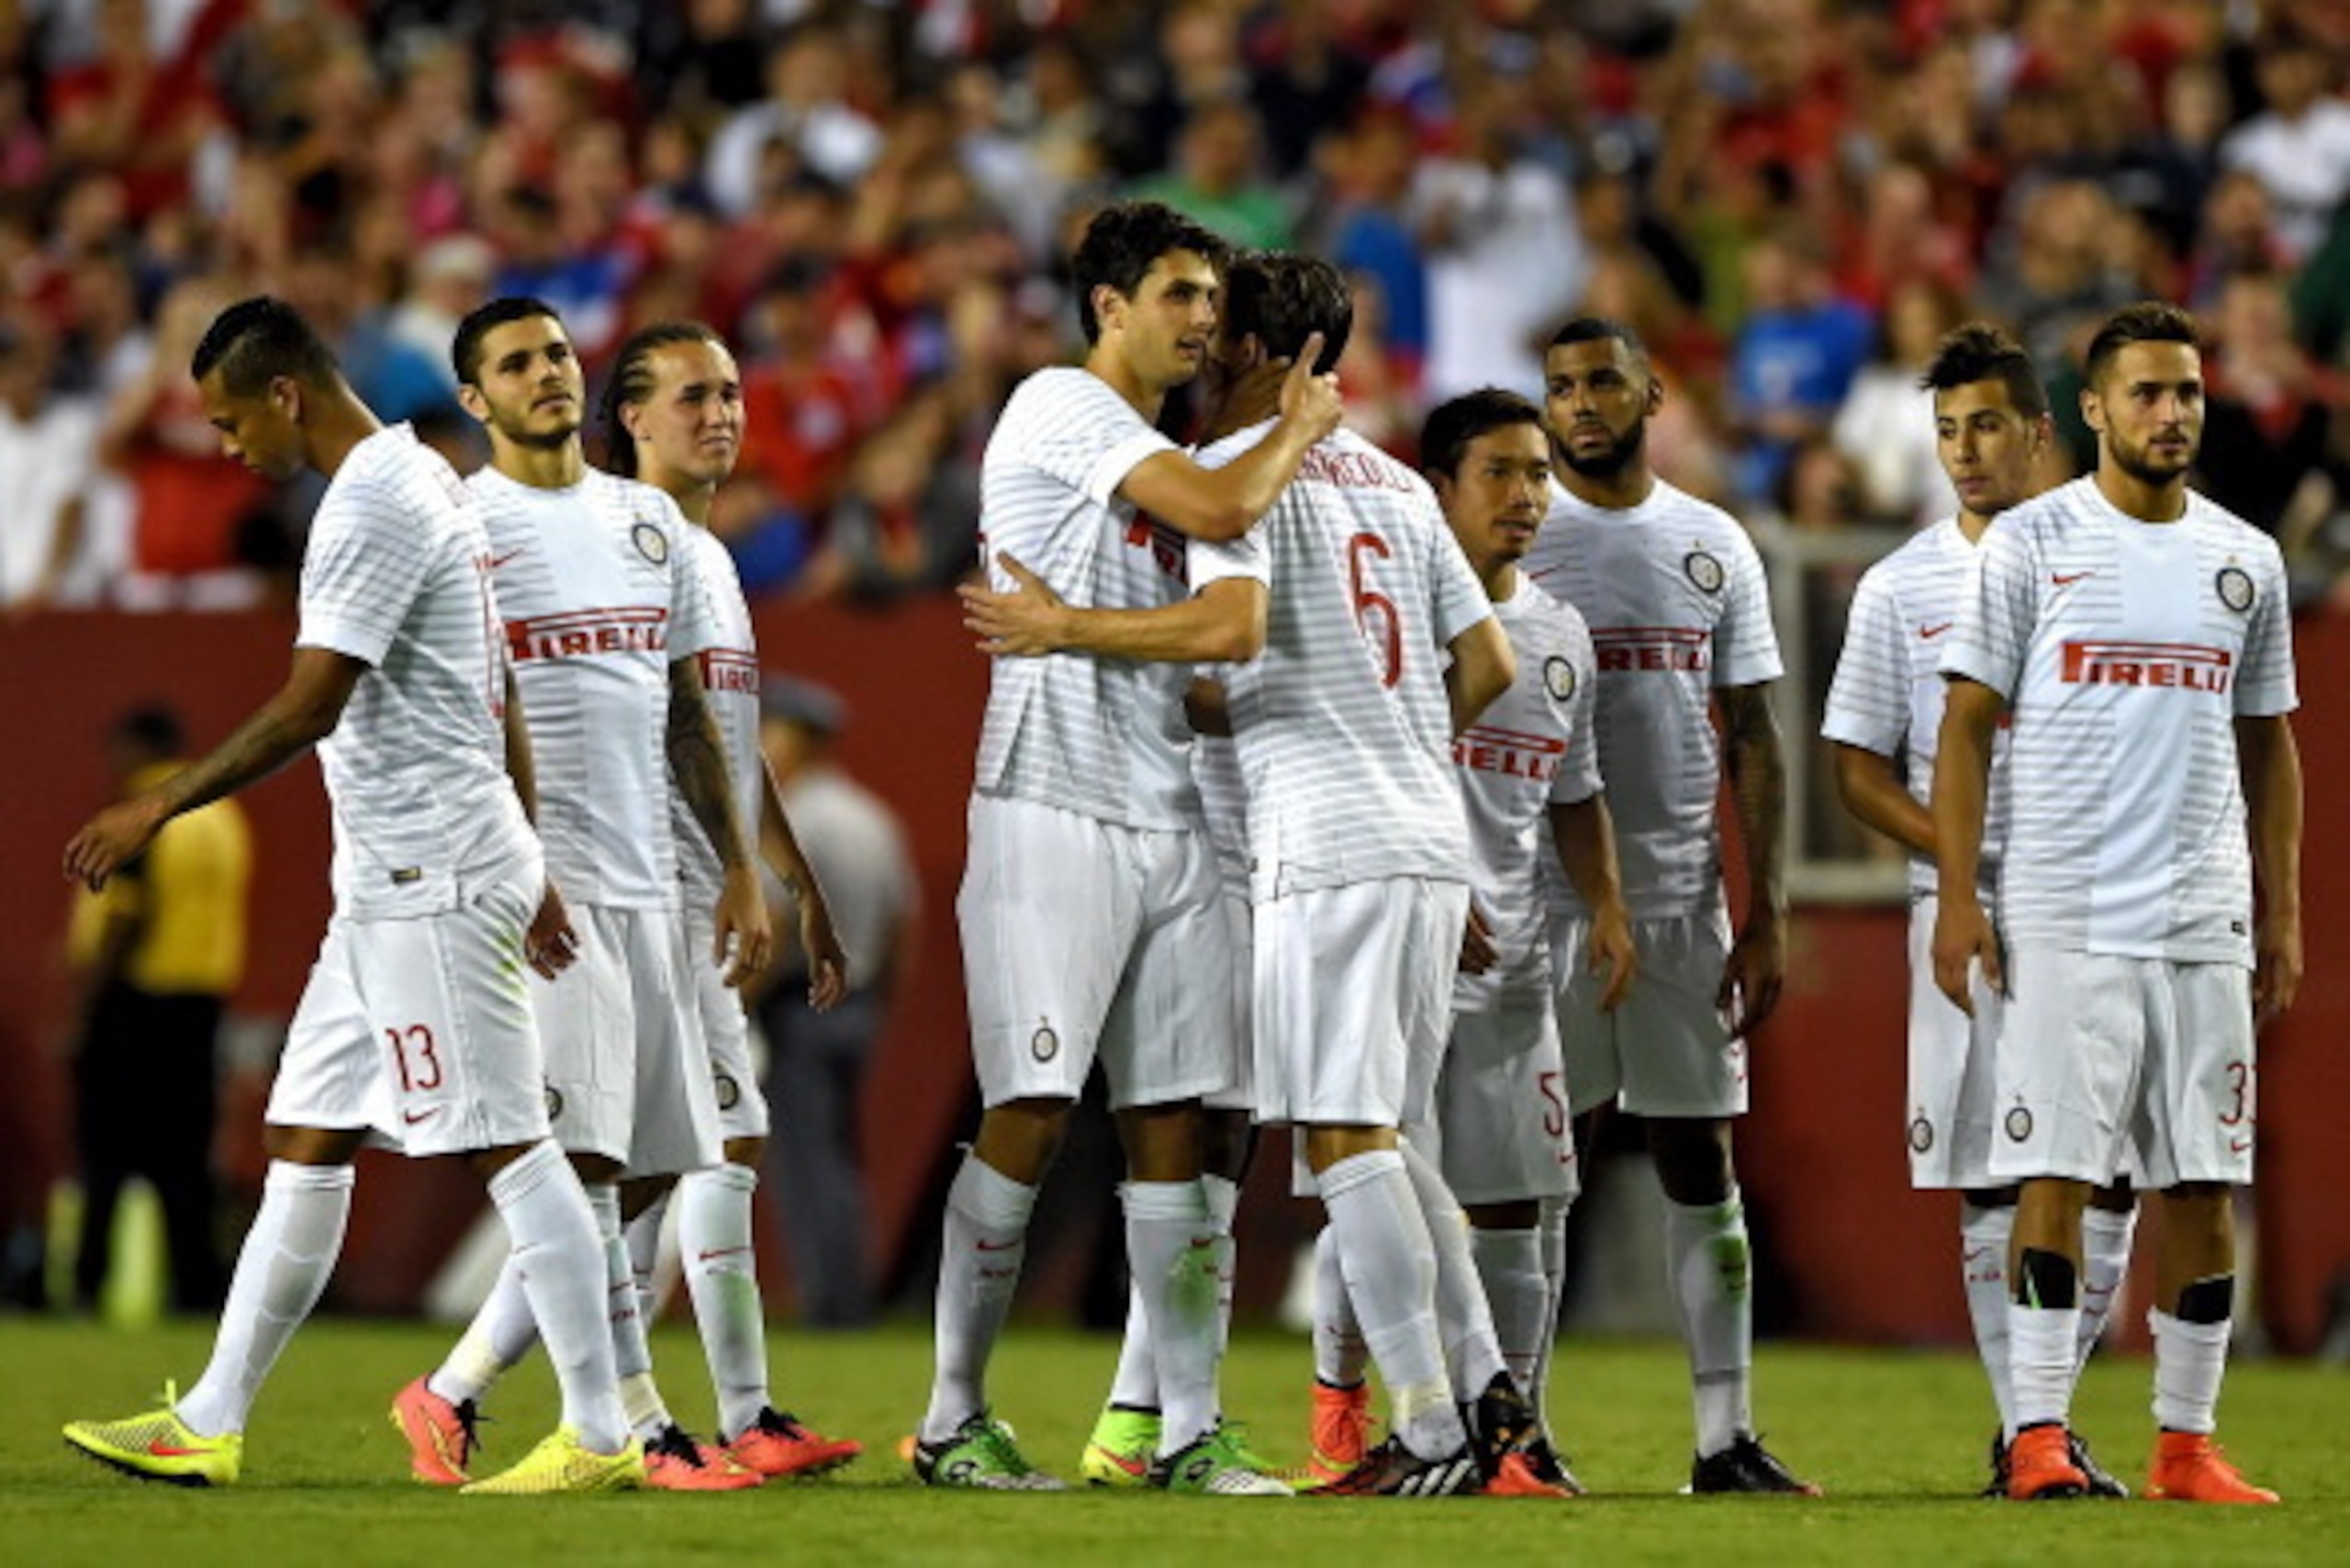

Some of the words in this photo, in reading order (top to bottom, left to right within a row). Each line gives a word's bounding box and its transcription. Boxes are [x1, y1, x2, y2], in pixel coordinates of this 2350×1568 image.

[1349, 532, 1402, 689] 6
[2060, 641, 2231, 694] PIRELLI
[386, 1025, 441, 1092] 13
[2219, 1060, 2256, 1126] 3
